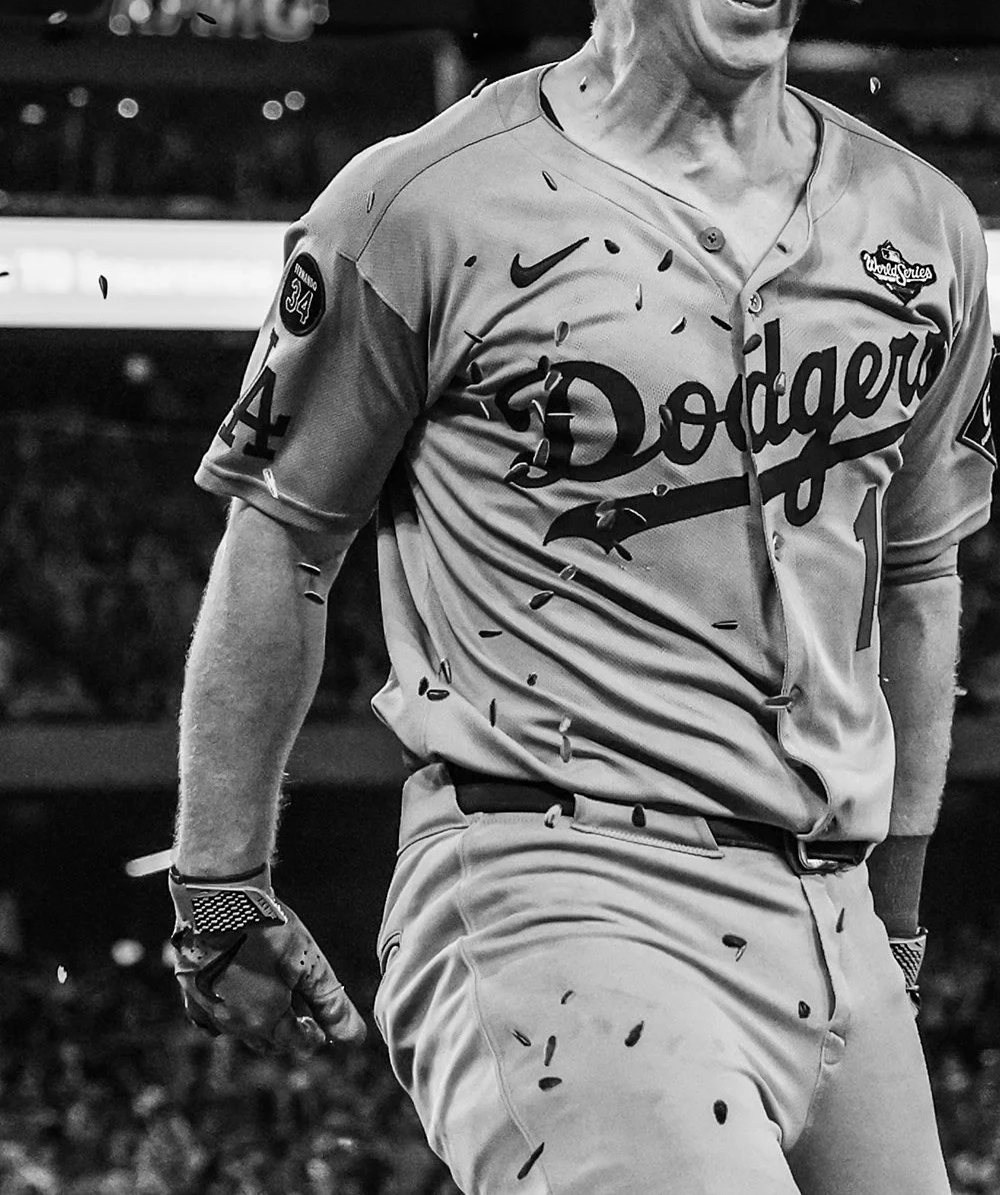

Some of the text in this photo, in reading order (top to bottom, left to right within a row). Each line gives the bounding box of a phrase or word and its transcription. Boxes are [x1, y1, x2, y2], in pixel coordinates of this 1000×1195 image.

[285, 277, 314, 325] 34
[495, 319, 947, 527] Dodgers
[853, 485, 878, 652] 1
